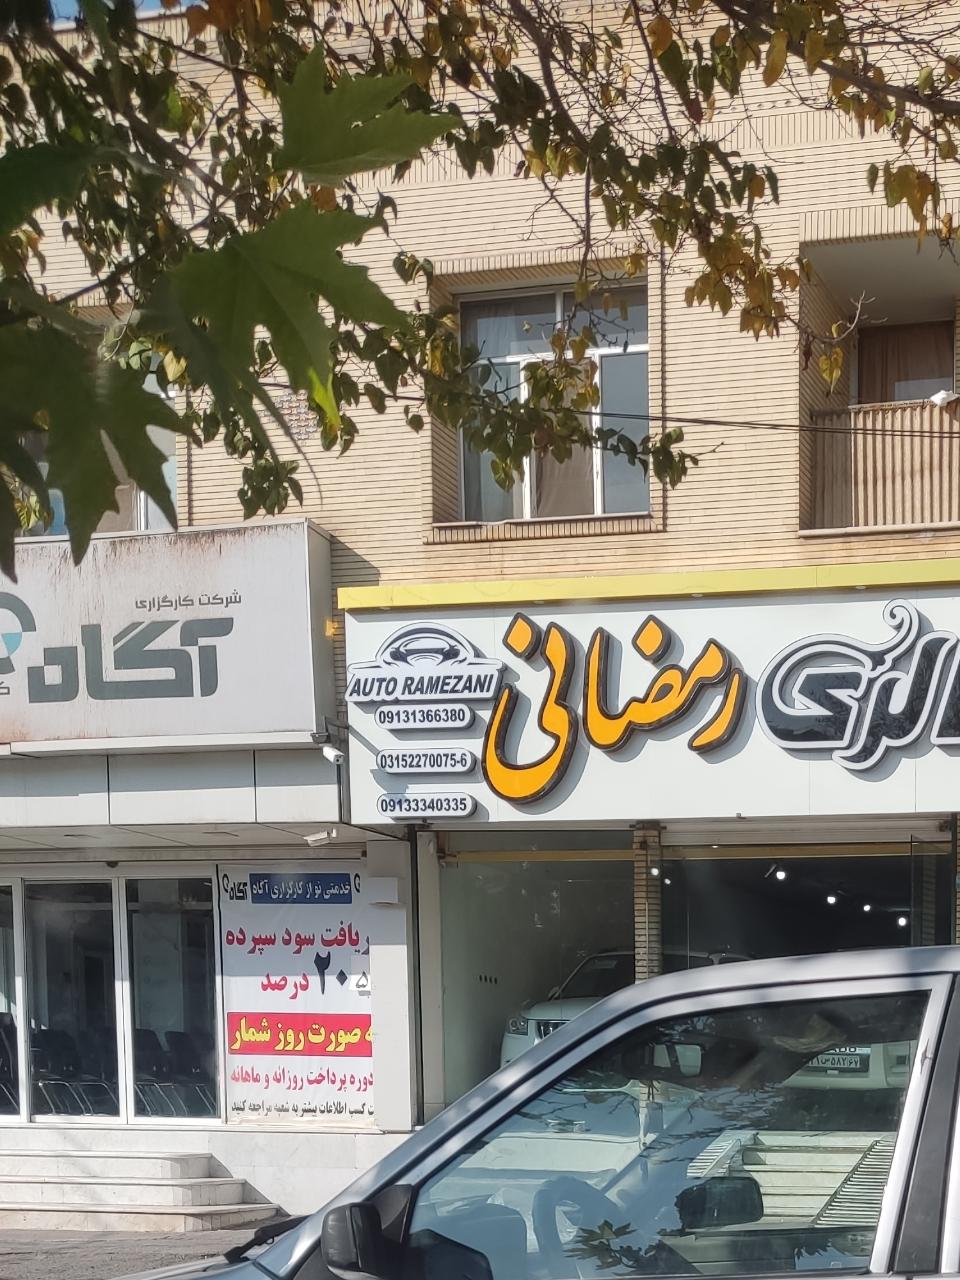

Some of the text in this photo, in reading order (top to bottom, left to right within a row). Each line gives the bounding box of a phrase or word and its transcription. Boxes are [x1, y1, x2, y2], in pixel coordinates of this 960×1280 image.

[135, 588, 242, 612] شرکت کارگزاری
[27, 617, 234, 704] آگاه
[349, 674, 494, 697] AUTO RAMEZANI
[378, 708, 465, 724] 09131366380
[482, 612, 748, 804] رمضانی
[380, 753, 467, 769] 03152270075-6
[381, 798, 467, 813] 09133340335
[252, 879, 269, 894] آگاه
[271, 880, 303, 899] کارگزاری
[323, 881, 351, 900] خدمتی
[225, 920, 370, 956] ریافت سود سپرده
[260, 971, 310, 999] درصد
[308, 1022, 361, 1052] صورت
[230, 1065, 261, 1084] ماهانه
[264, 1073, 270, 1090] و
[272, 1065, 304, 1091] روزانه
[306, 1066, 347, 1092] پرداخت
[318, 1101, 347, 1115] اطلاعات
